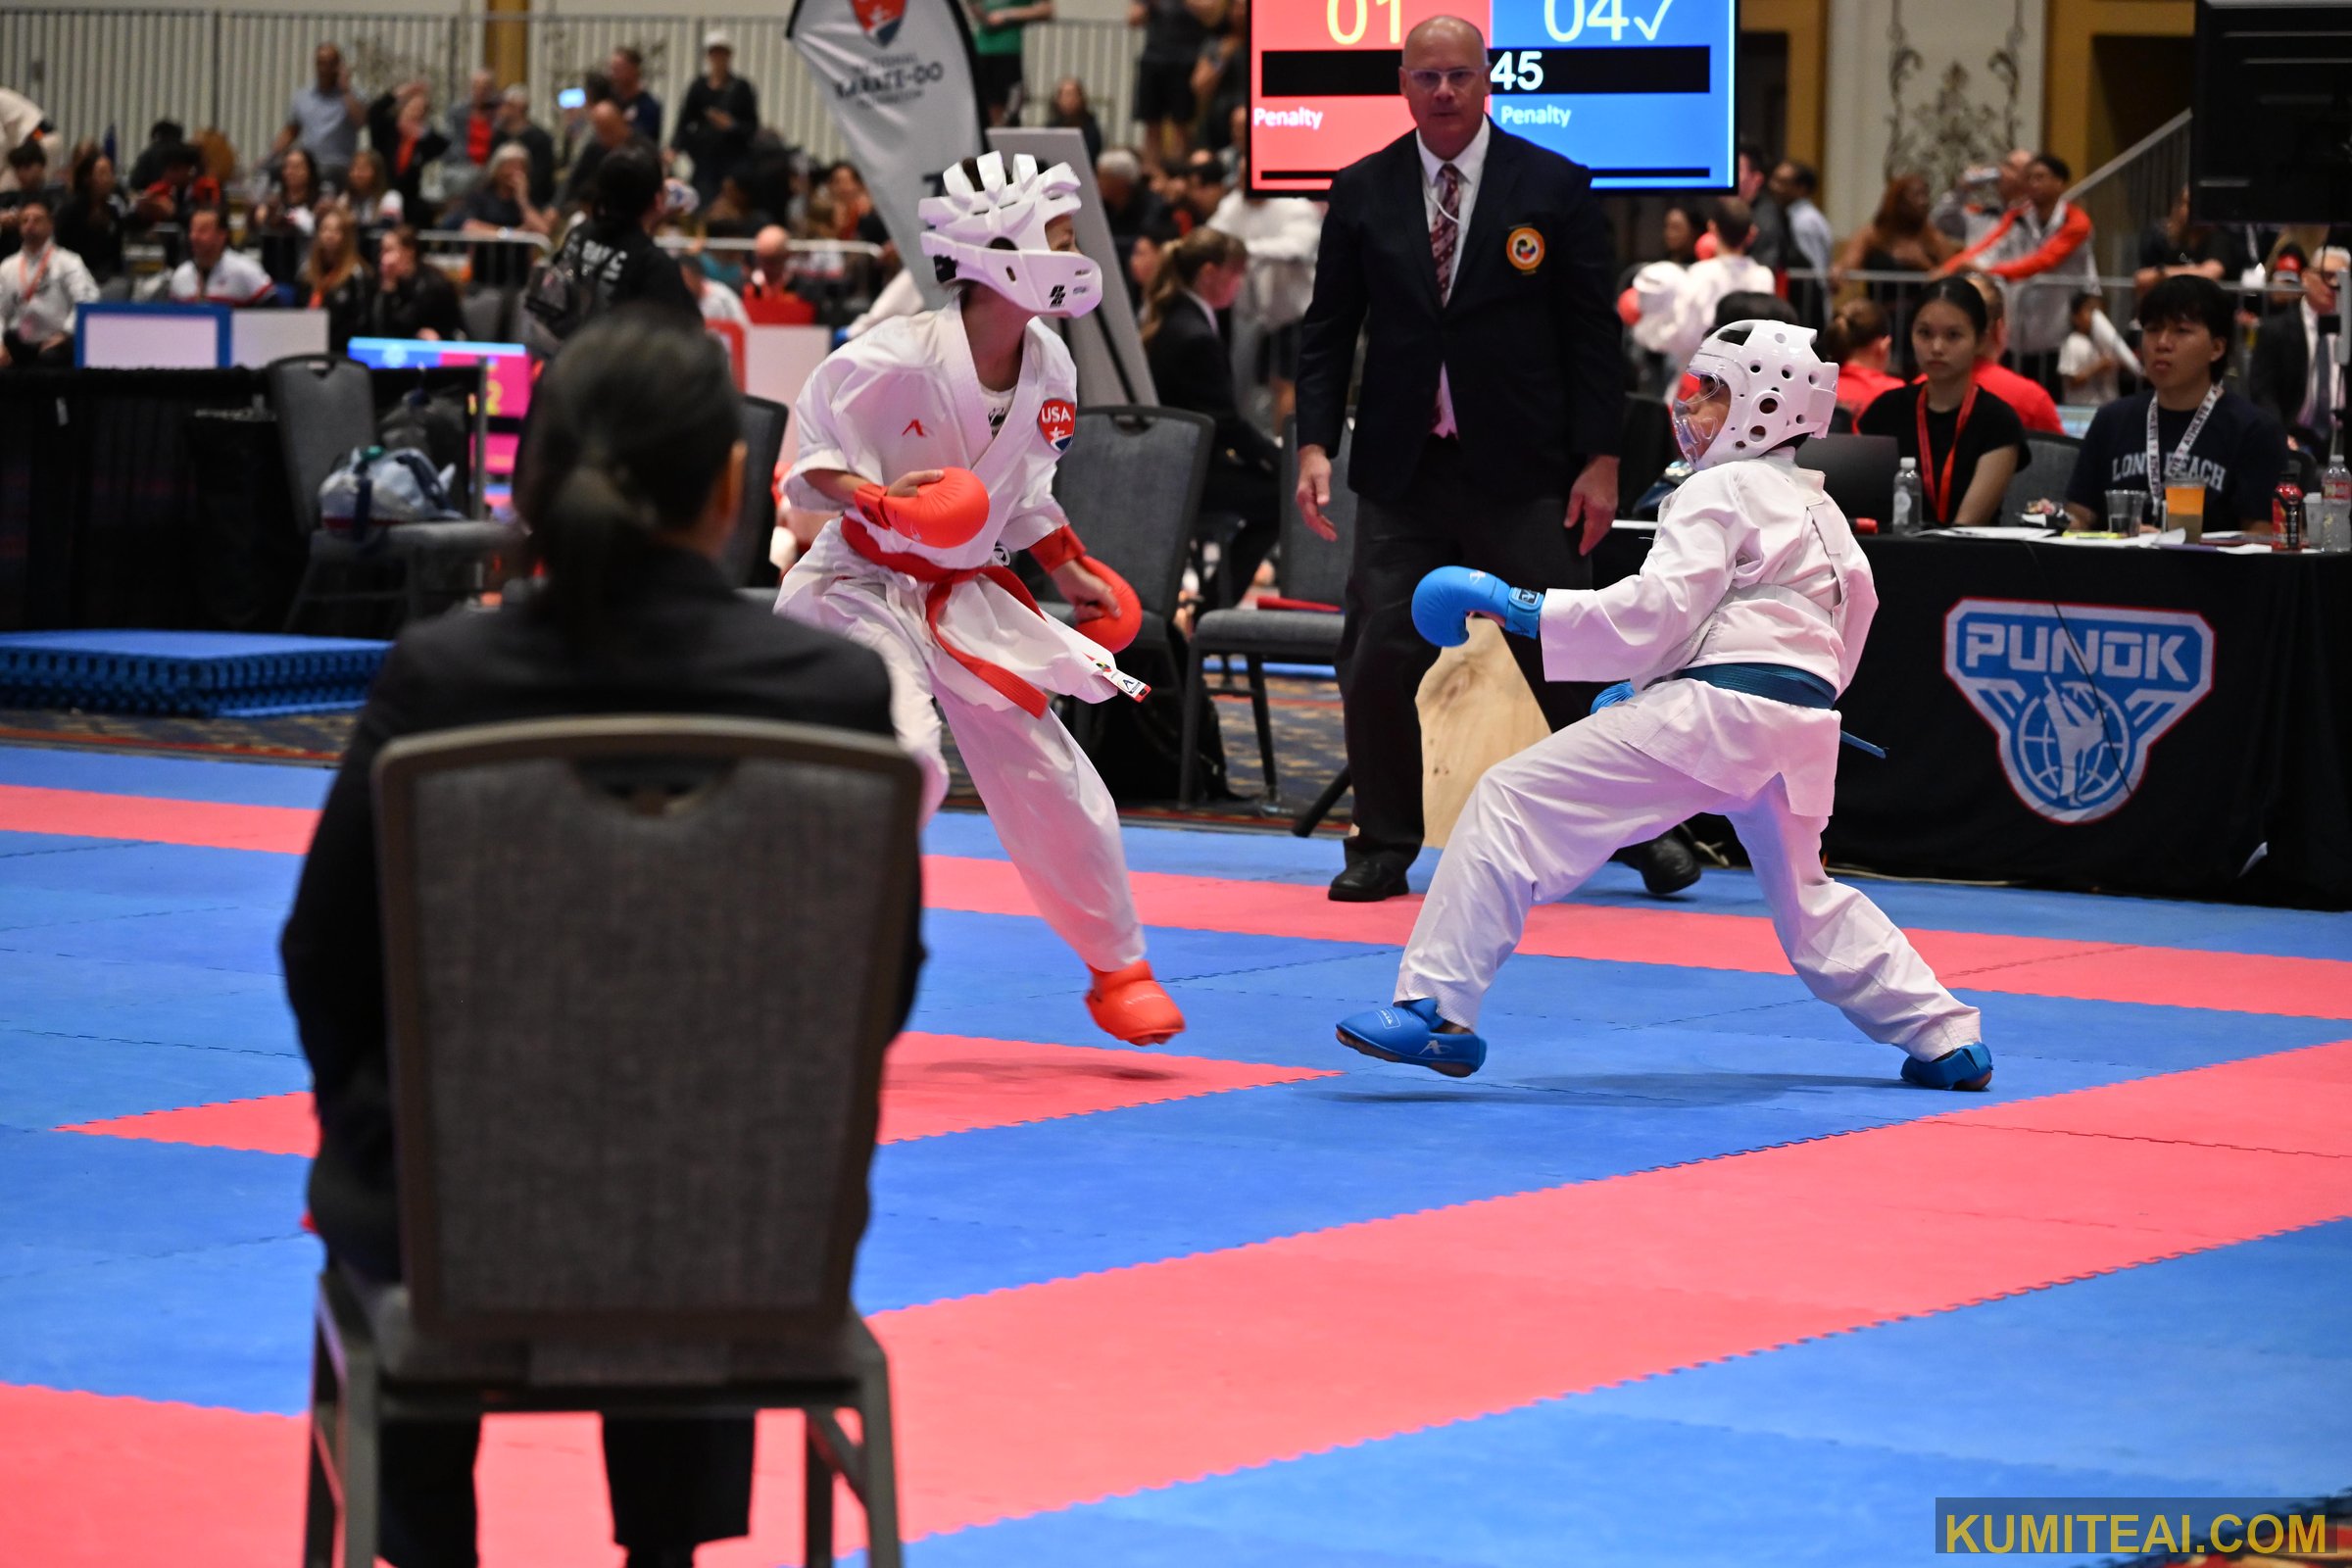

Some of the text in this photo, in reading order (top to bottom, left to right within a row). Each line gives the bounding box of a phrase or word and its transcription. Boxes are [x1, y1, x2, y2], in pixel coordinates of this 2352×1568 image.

[1326, 0, 1401, 45] 01
[1490, 51, 1544, 91] 45
[1253, 106, 1323, 130] Penalty
[1501, 104, 1572, 127] Penalty
[1041, 406, 1072, 423] USA
[2112, 452, 2148, 482] LON
[1965, 621, 2189, 683] PUNOK
